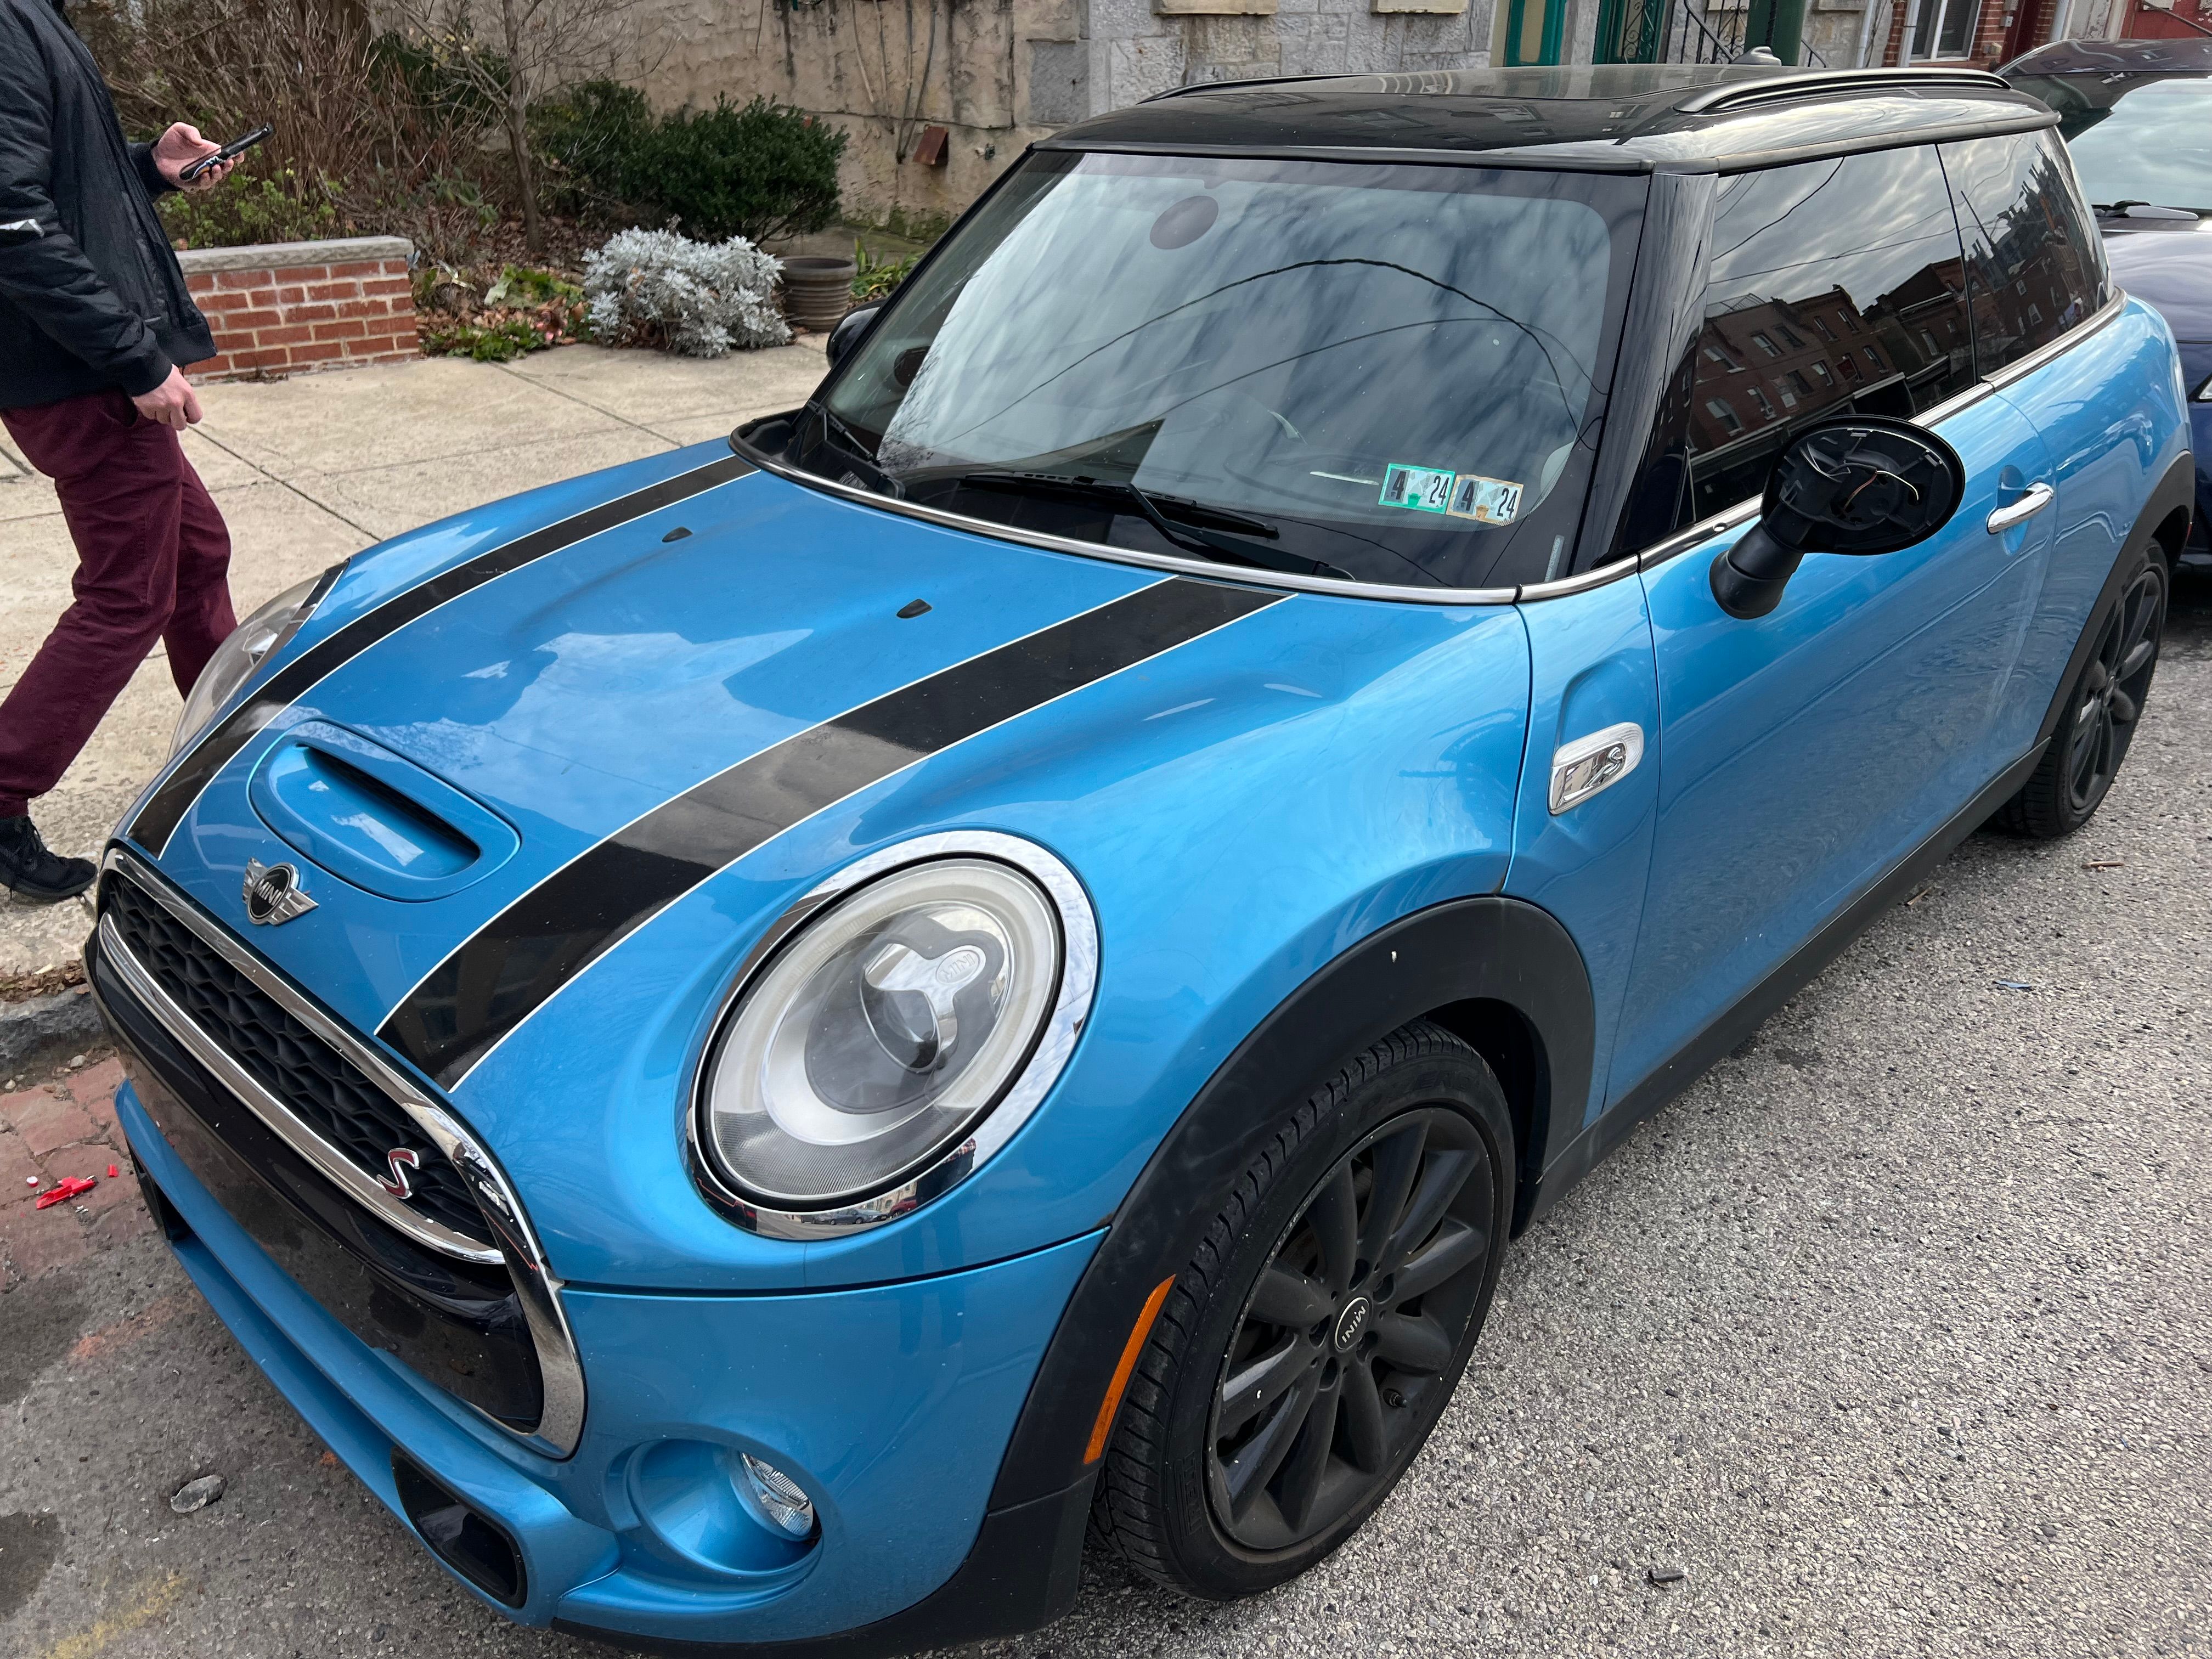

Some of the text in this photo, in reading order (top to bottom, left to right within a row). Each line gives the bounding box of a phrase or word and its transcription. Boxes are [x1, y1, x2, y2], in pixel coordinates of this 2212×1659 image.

[1392, 471, 1407, 500] 4
[1429, 475, 1449, 505] 24
[1462, 481, 1474, 511] 4
[1497, 488, 1518, 518] 24
[254, 878, 283, 906] MINI
[940, 953, 975, 984] MINI
[376, 1147, 420, 1199] S
[1341, 1306, 1366, 1343] MINI
